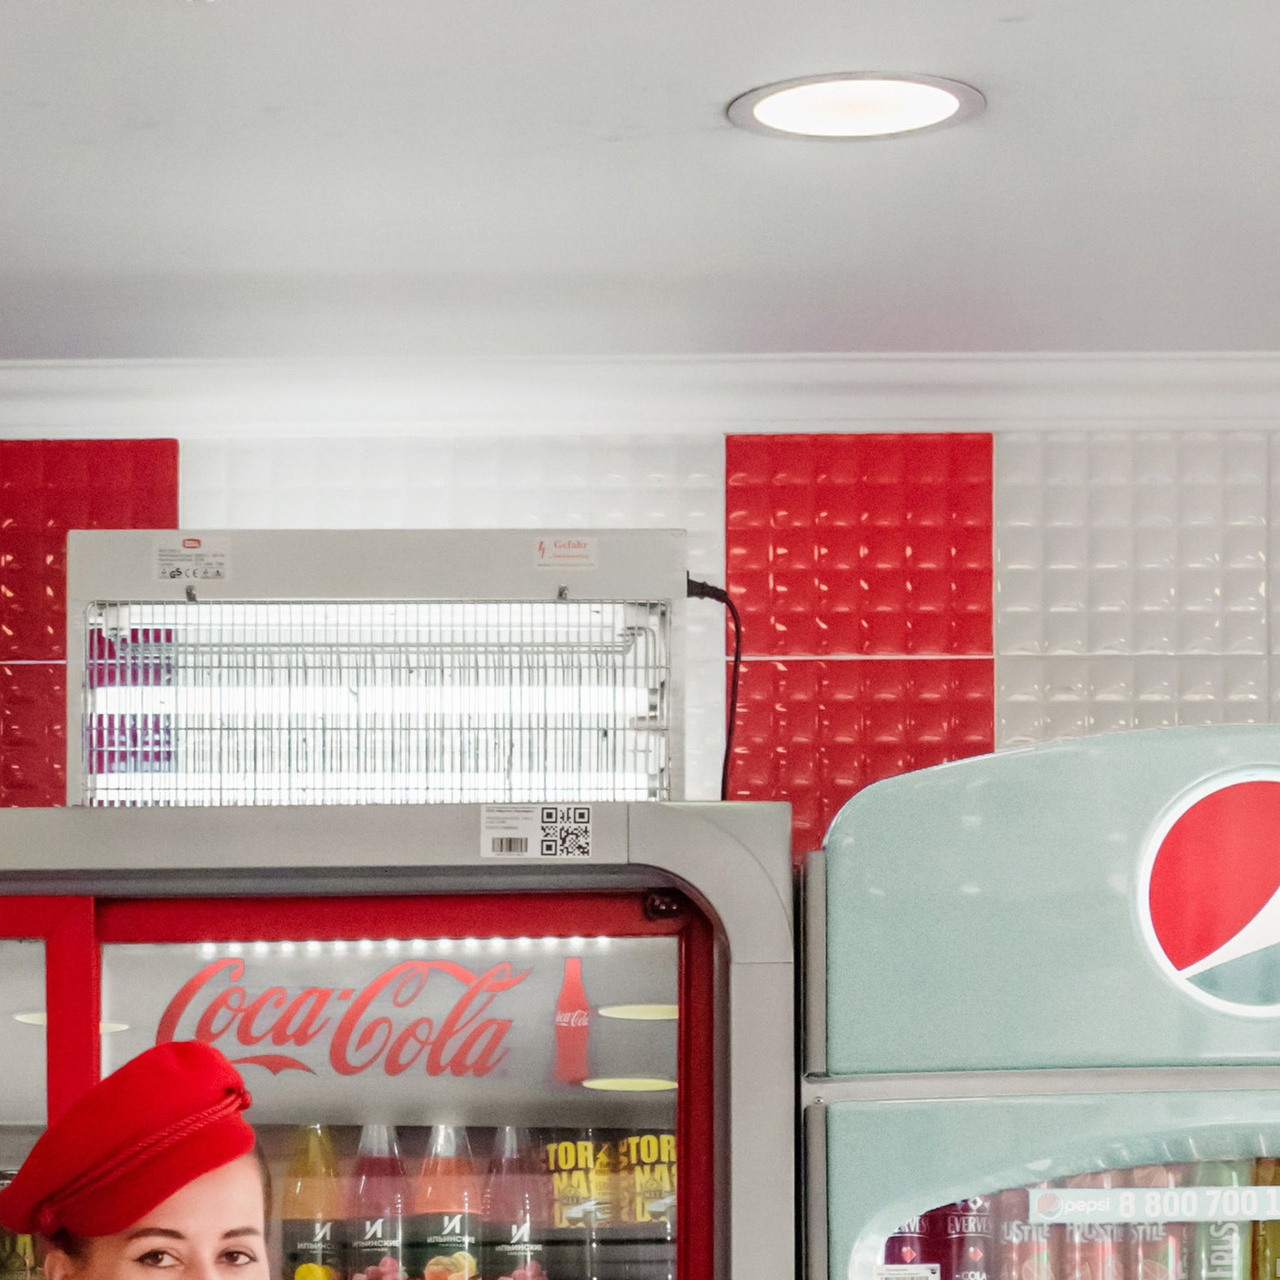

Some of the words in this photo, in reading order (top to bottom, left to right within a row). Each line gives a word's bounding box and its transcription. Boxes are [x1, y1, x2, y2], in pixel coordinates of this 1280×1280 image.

[1065, 1198, 1110, 1215] pepsi
[1118, 1191, 1135, 1217] 8
[1145, 1190, 1198, 1217] 800
[1206, 1190, 1257, 1216] 700
